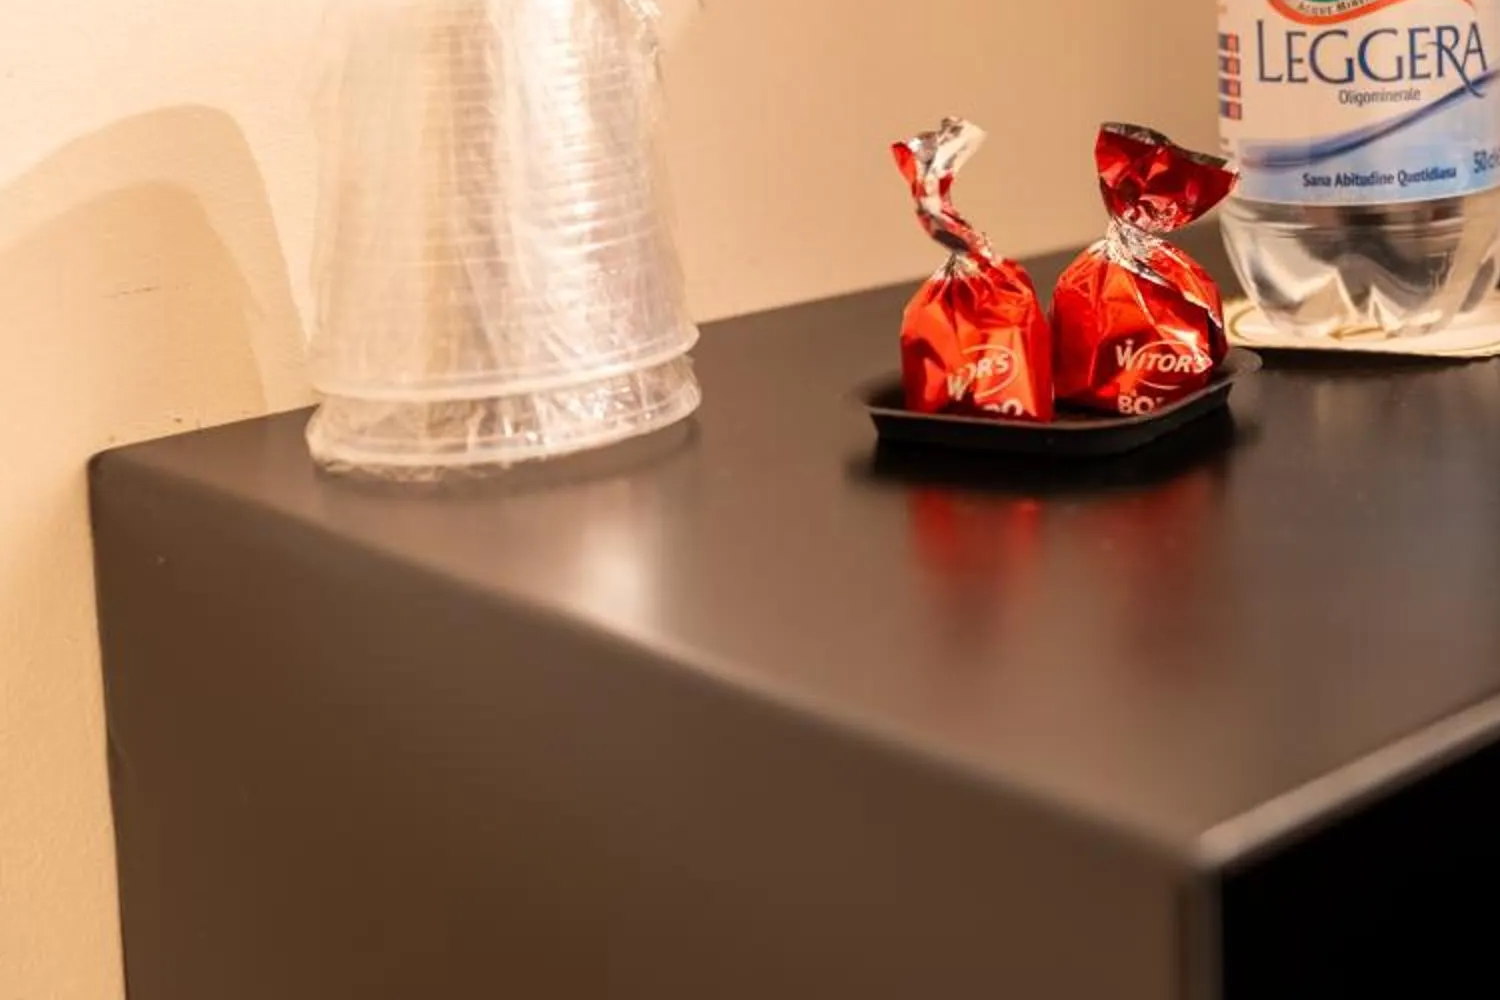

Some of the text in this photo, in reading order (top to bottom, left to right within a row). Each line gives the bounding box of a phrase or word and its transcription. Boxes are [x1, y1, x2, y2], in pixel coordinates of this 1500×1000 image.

[1256, 18, 1488, 98] LEGGERA
[1339, 88, 1421, 107] Oligominerale
[1302, 167, 1457, 188] Sana Abitudine Quotidiana
